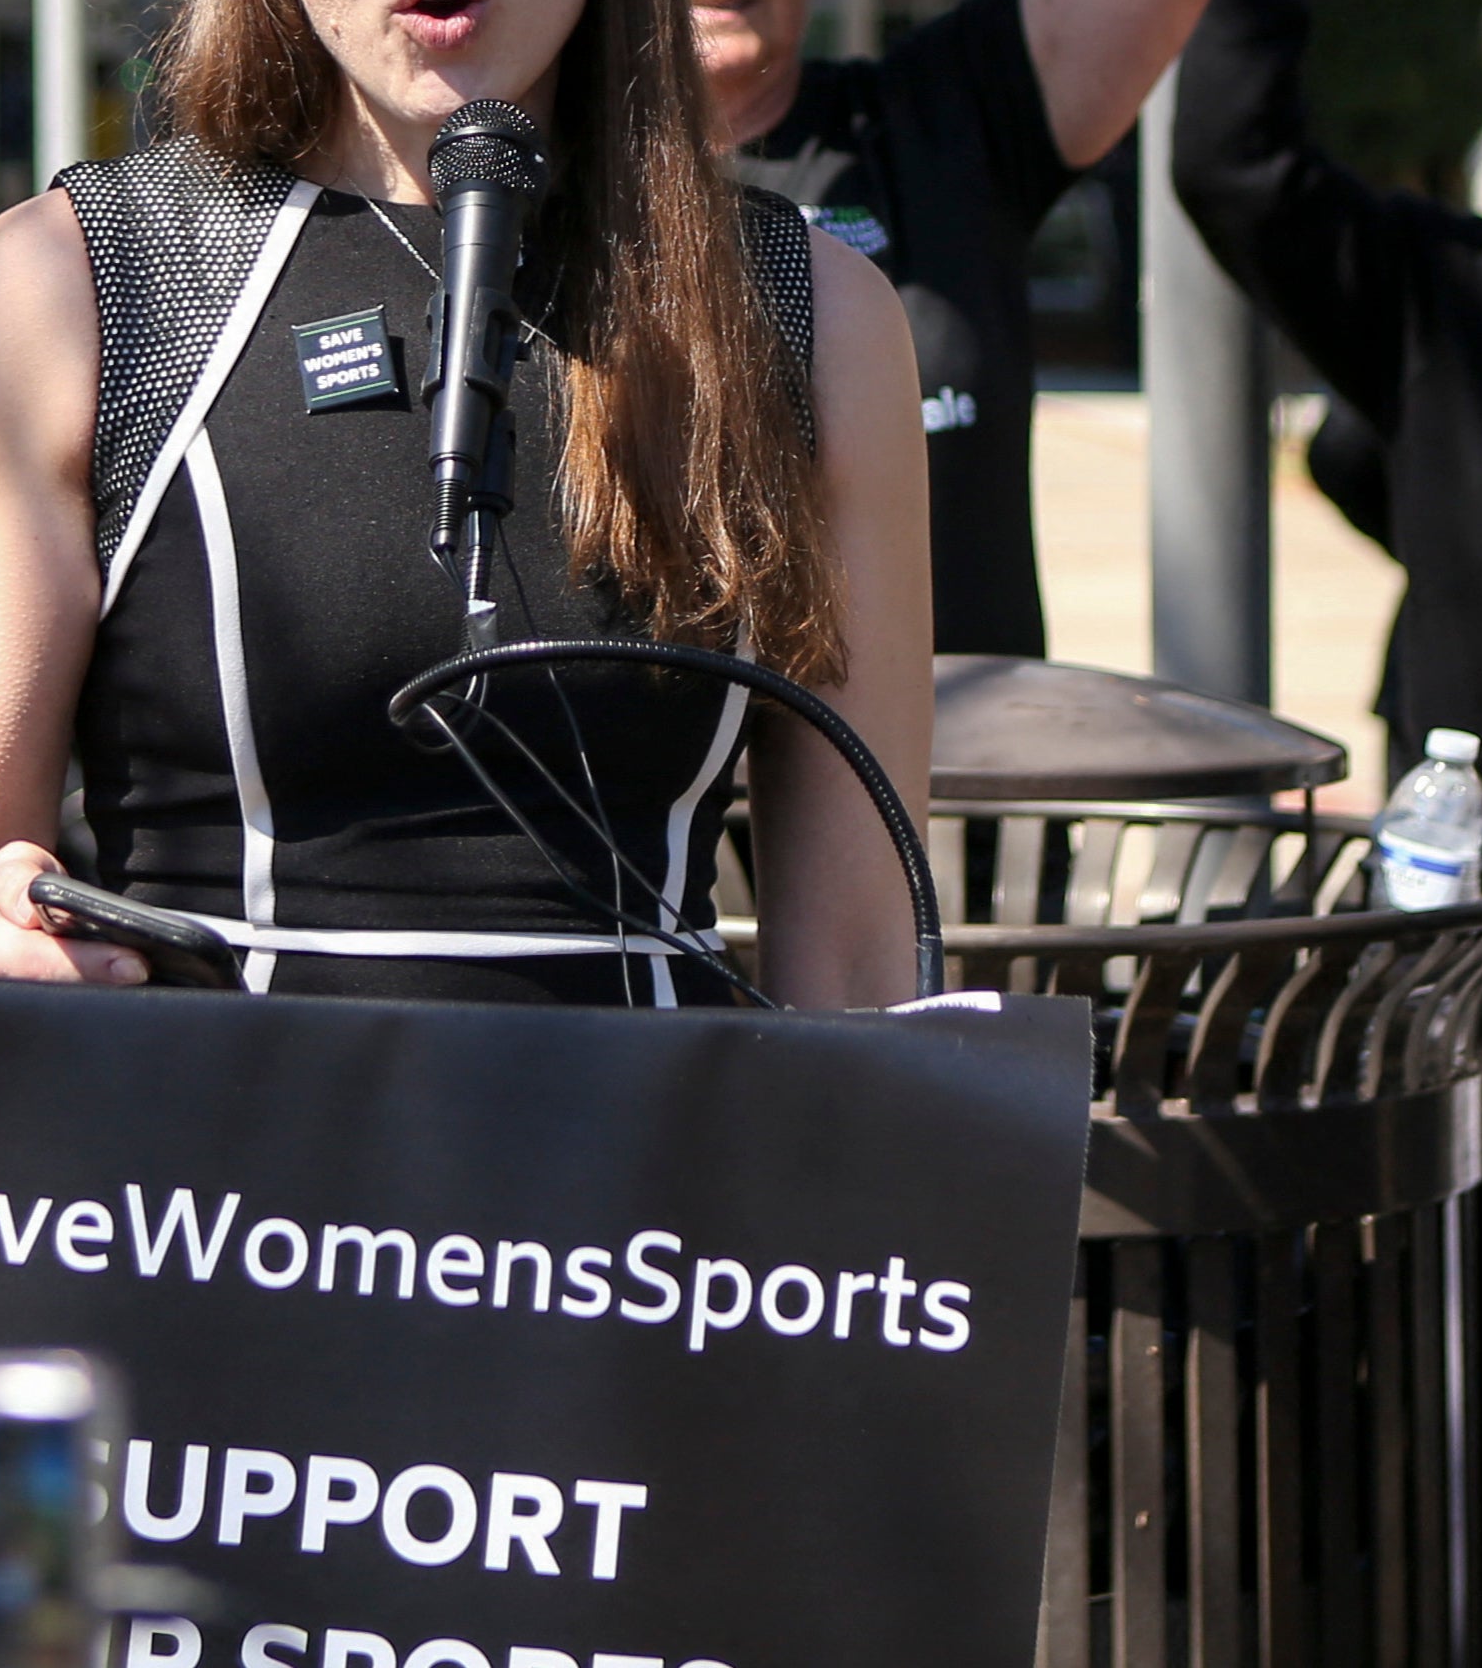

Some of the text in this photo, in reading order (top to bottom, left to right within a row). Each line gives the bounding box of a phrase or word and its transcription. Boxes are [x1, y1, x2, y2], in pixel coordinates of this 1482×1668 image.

[318, 327, 365, 350] SAVE
[303, 342, 384, 373] WOMEN'S
[316, 363, 381, 390] SPORTS
